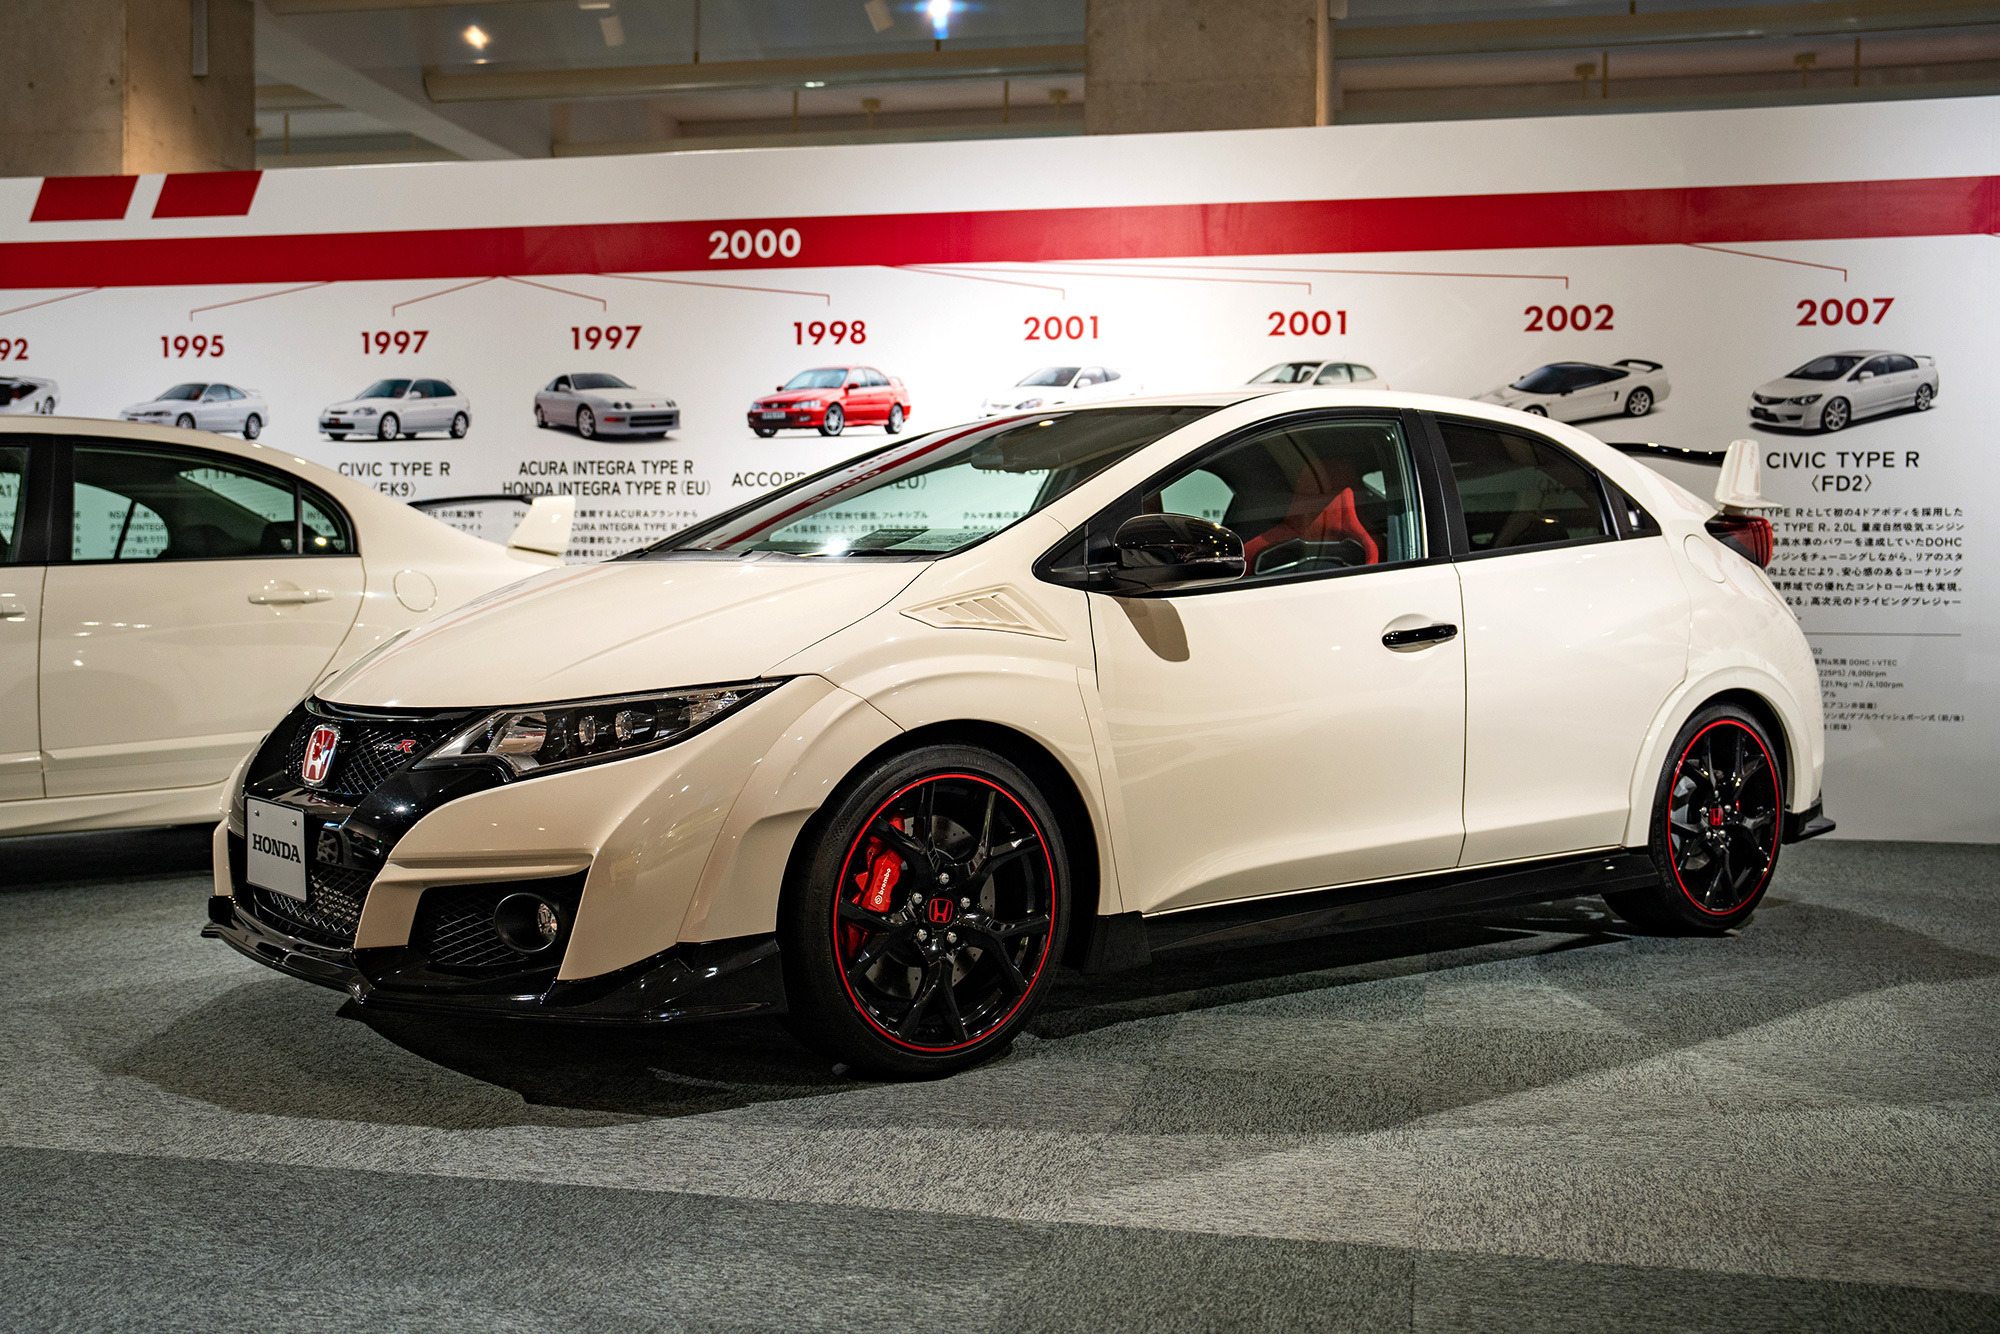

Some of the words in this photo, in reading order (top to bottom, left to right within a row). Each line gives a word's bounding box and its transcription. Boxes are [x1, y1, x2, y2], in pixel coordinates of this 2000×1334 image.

[708, 227, 802, 260] 2000
[1268, 311, 1347, 336] 2001
[1525, 303, 1614, 332] 2002
[1797, 297, 1895, 327] 2007
[571, 326, 642, 351] 1997
[793, 321, 866, 346] 1998
[1024, 316, 1098, 341] 2001
[160, 334, 225, 358] 1995
[361, 330, 429, 355] 1997
[338, 461, 383, 476] CIVIC
[390, 461, 433, 477] TYPE
[439, 461, 451, 476] R
[518, 460, 569, 476] ACURA
[573, 460, 636, 476] INTEGRA
[642, 459, 678, 475] TYPE
[683, 459, 694, 475] R
[1766, 451, 1826, 469] CIVIC
[1836, 451, 1895, 468] TYPE
[1906, 451, 1920, 468] R
[502, 481, 554, 496] HONDA
[558, 480, 622, 496] INTEGRA
[625, 480, 662, 496] TYPE
[666, 480, 677, 495] R
[731, 472, 806, 488] ACCOR
[1784, 522, 1814, 533] TYPE
[252, 833, 302, 864] HONDA
[878, 868, 892, 896] brembo
